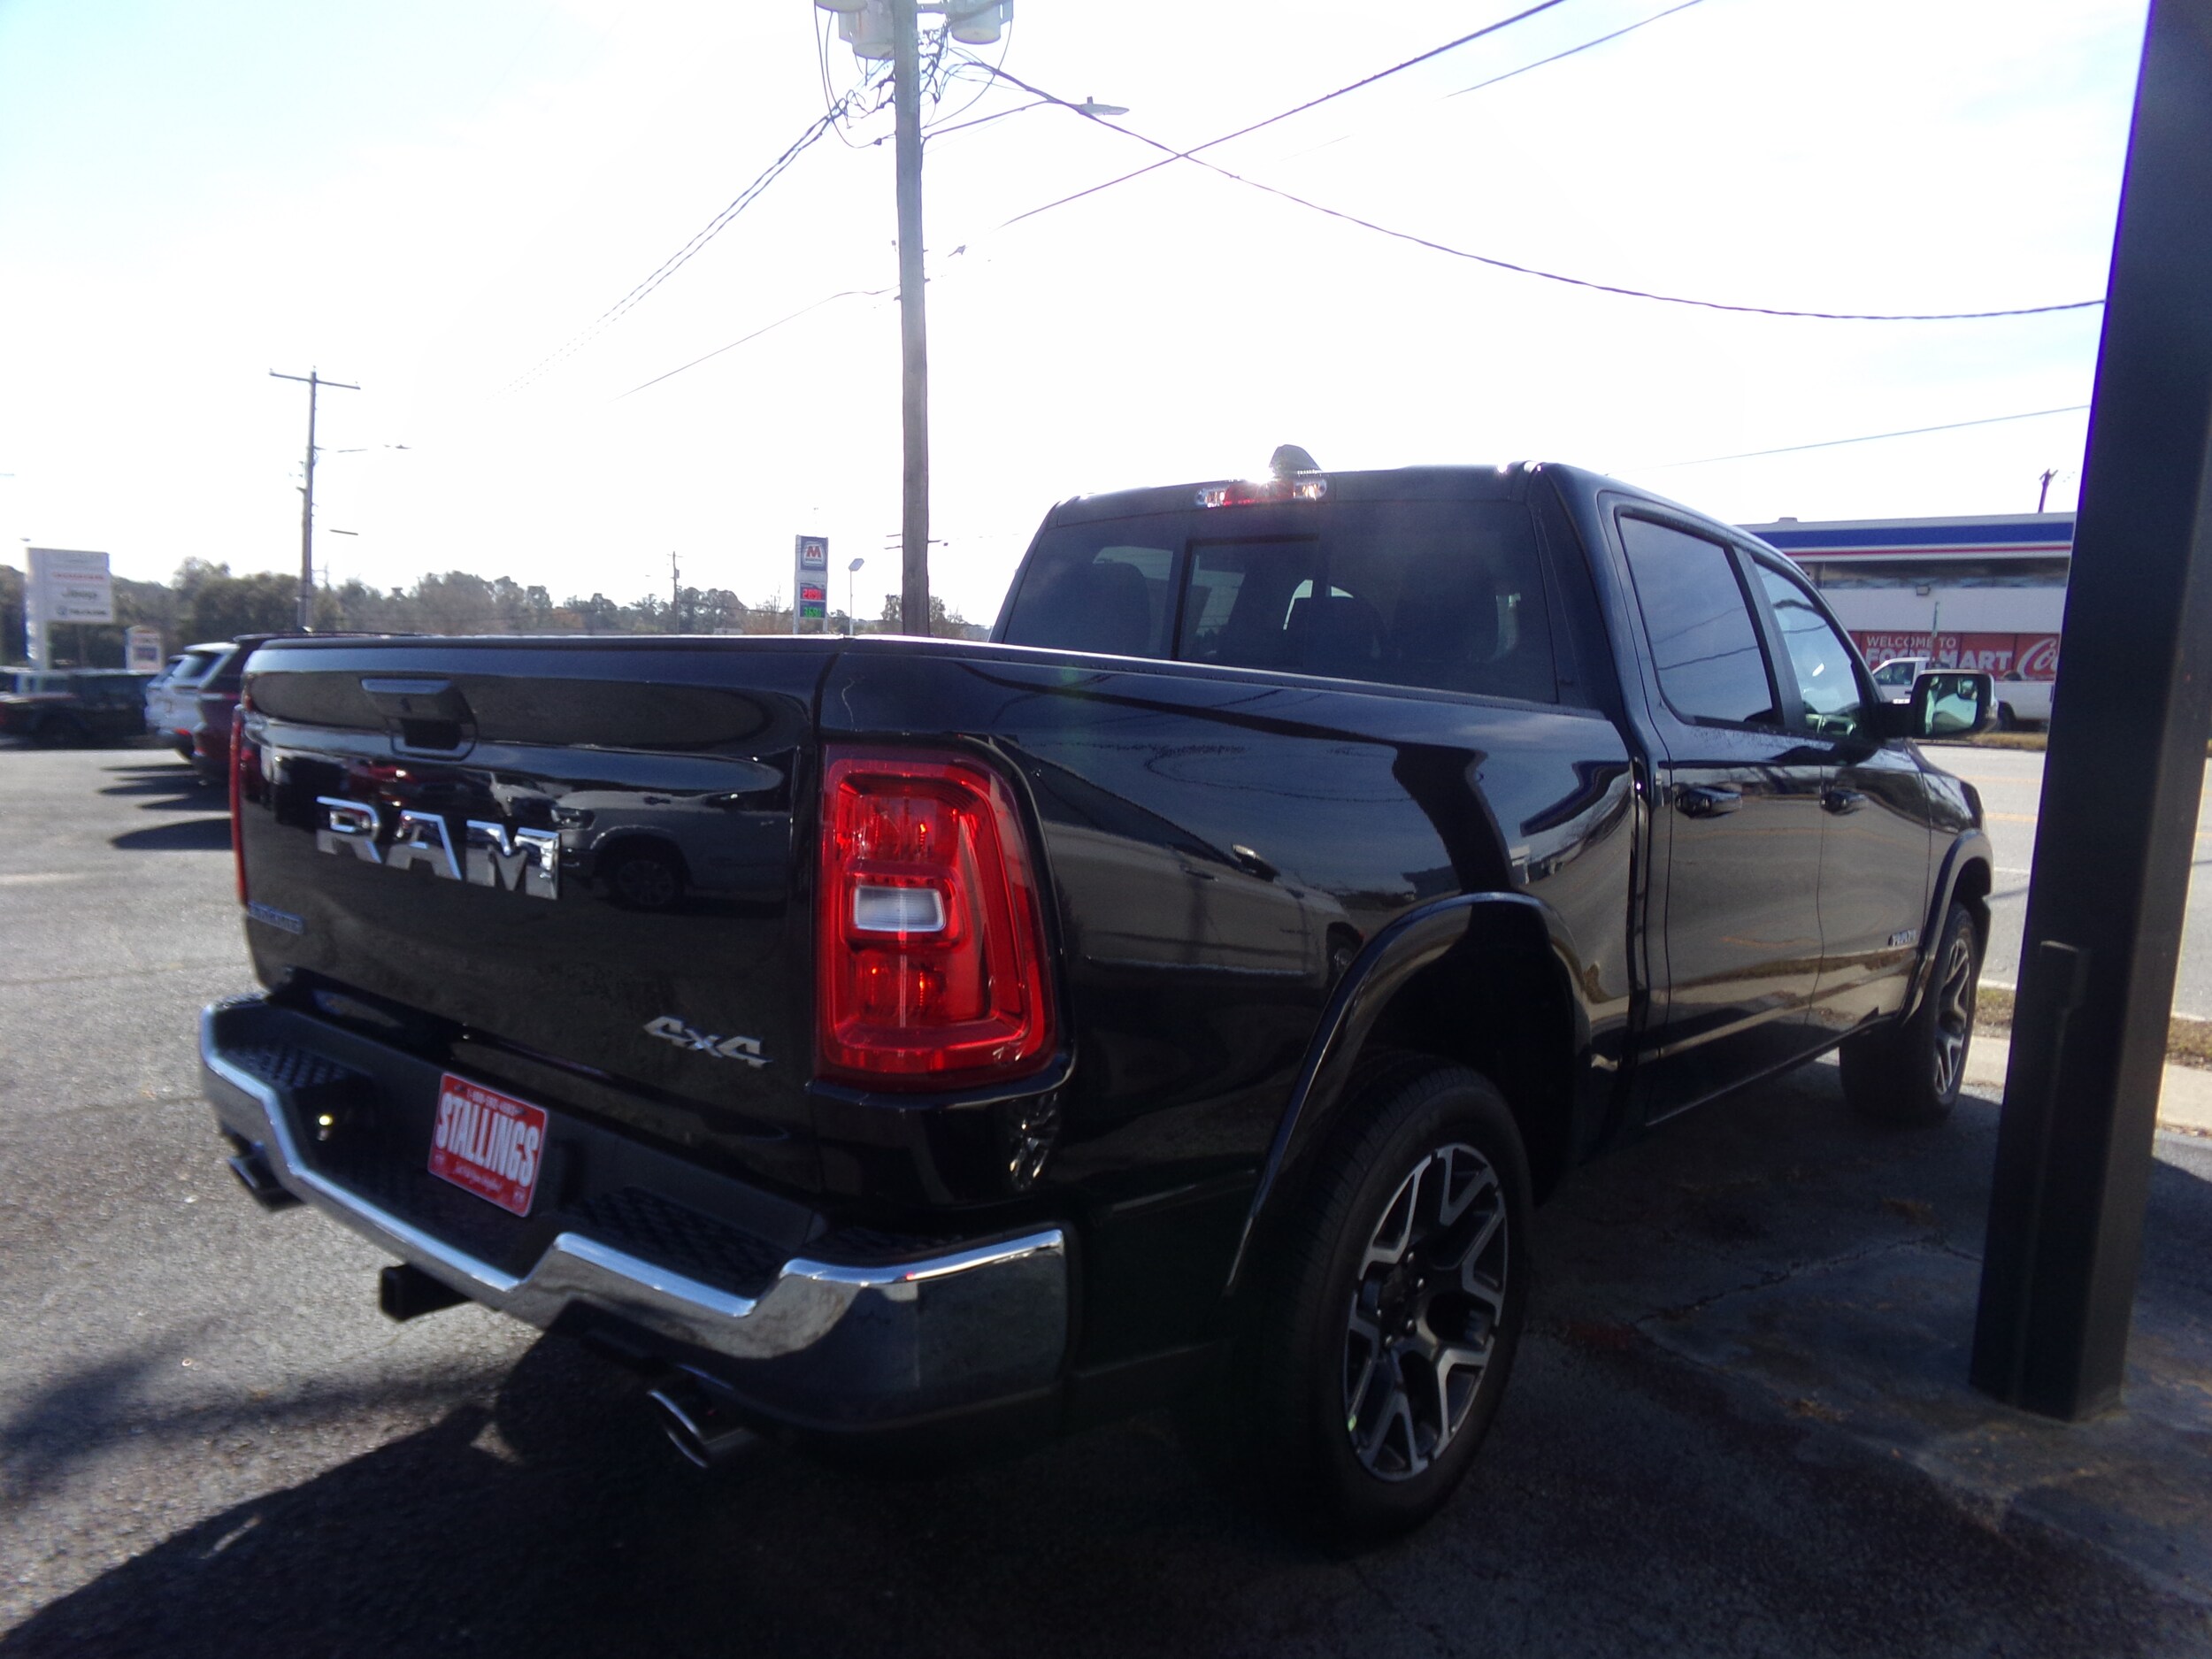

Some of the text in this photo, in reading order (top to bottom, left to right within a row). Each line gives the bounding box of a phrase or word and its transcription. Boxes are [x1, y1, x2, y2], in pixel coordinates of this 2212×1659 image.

[1866, 635, 1957, 649] WELCOME TO
[1939, 649, 2014, 671] MART
[317, 796, 560, 900] RAM
[435, 1092, 540, 1187] STALLINGS
